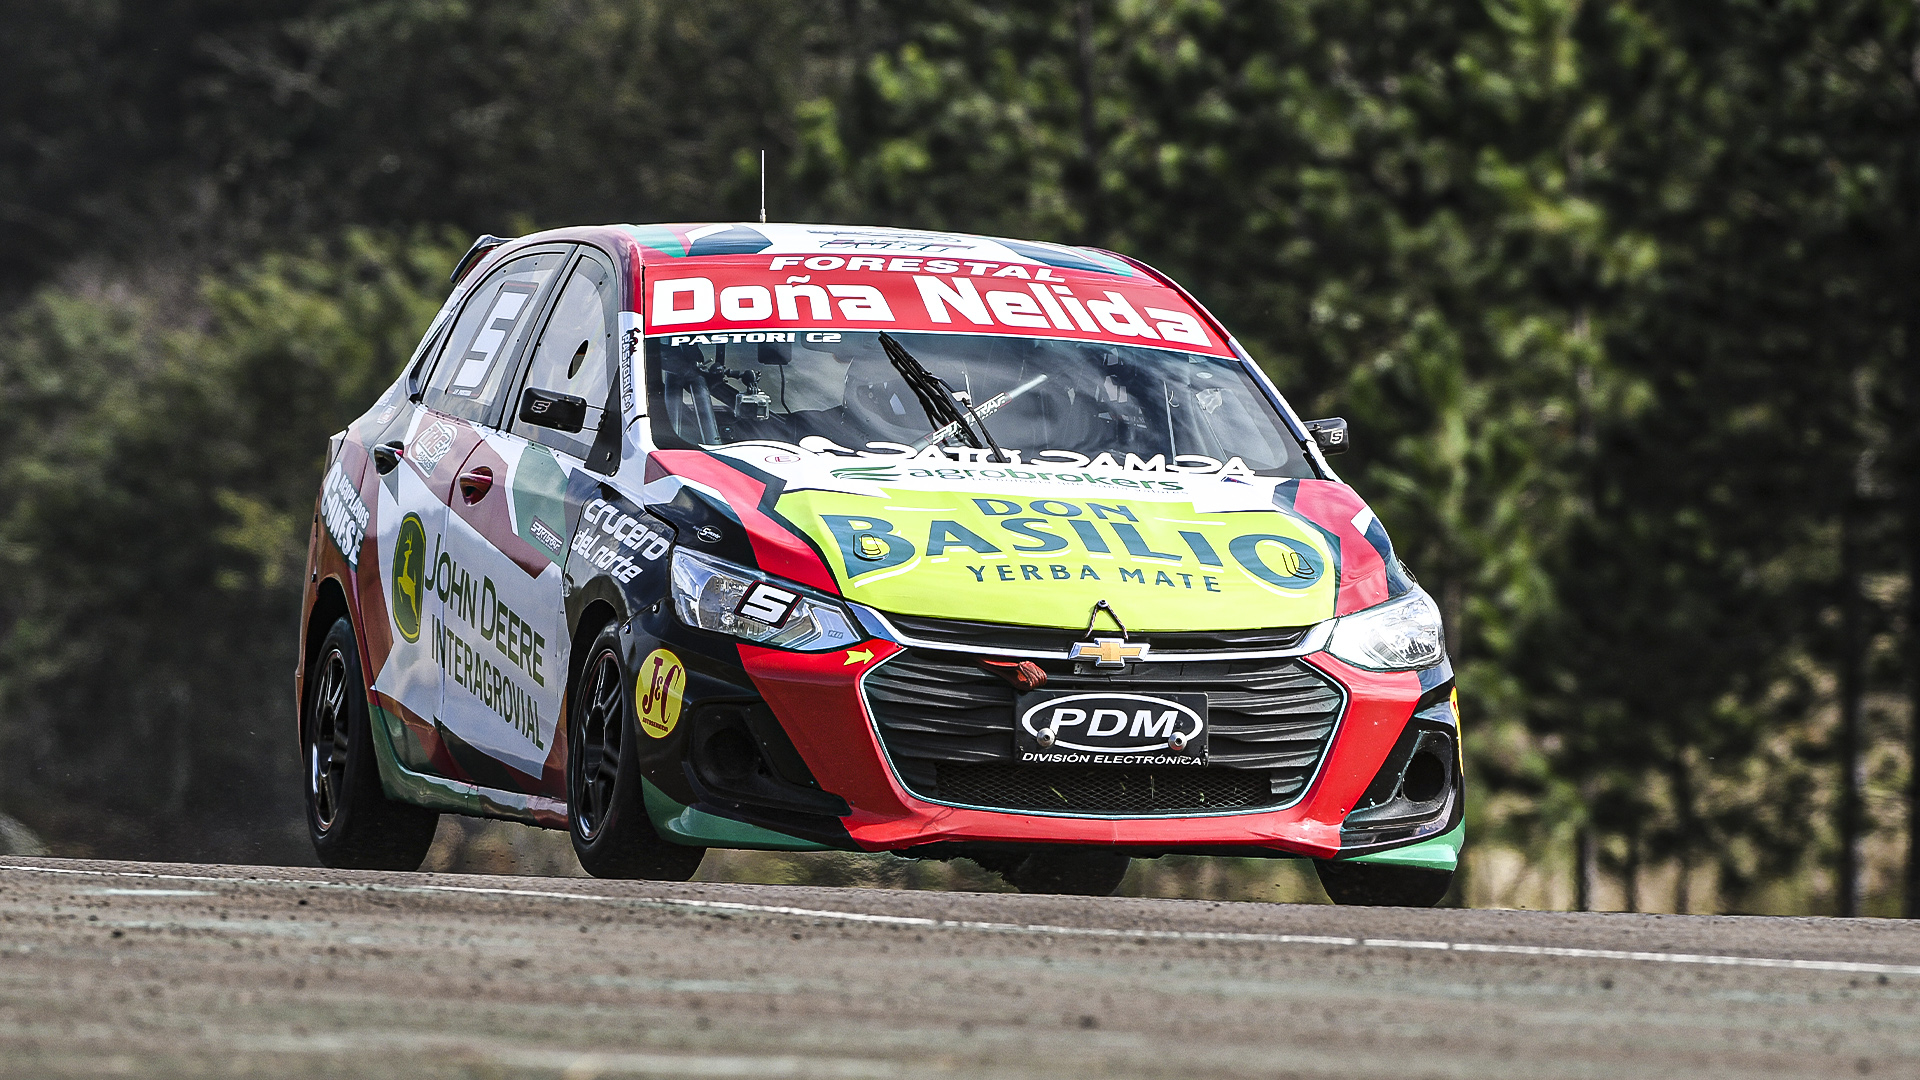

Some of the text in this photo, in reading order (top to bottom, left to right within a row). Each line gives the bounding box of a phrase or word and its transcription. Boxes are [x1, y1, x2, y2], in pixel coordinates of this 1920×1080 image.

[768, 255, 1065, 283] FORESTAL
[651, 275, 1213, 347] Doña Nelida
[453, 292, 528, 388] 5
[671, 332, 842, 347] PASTORI C2
[1330, 430, 1343, 443] 5
[338, 474, 370, 529] ACOPLADOS
[908, 468, 1184, 491] agrobrokers
[321, 461, 363, 566] CONESE
[971, 498, 1139, 522] DON
[571, 527, 600, 560] del
[594, 545, 643, 584] norte
[820, 514, 1325, 589] BASILIO
[966, 564, 1222, 593] YERBA MATE
[425, 533, 545, 688] JOHN DEERE
[740, 583, 797, 624] 5
[431, 614, 544, 751] INTERAGROVIAL
[642, 656, 682, 724] J&C
[1050, 708, 1179, 738] PDM
[1022, 752, 1202, 766] DIVISIÓN ELECTRÓNICA
